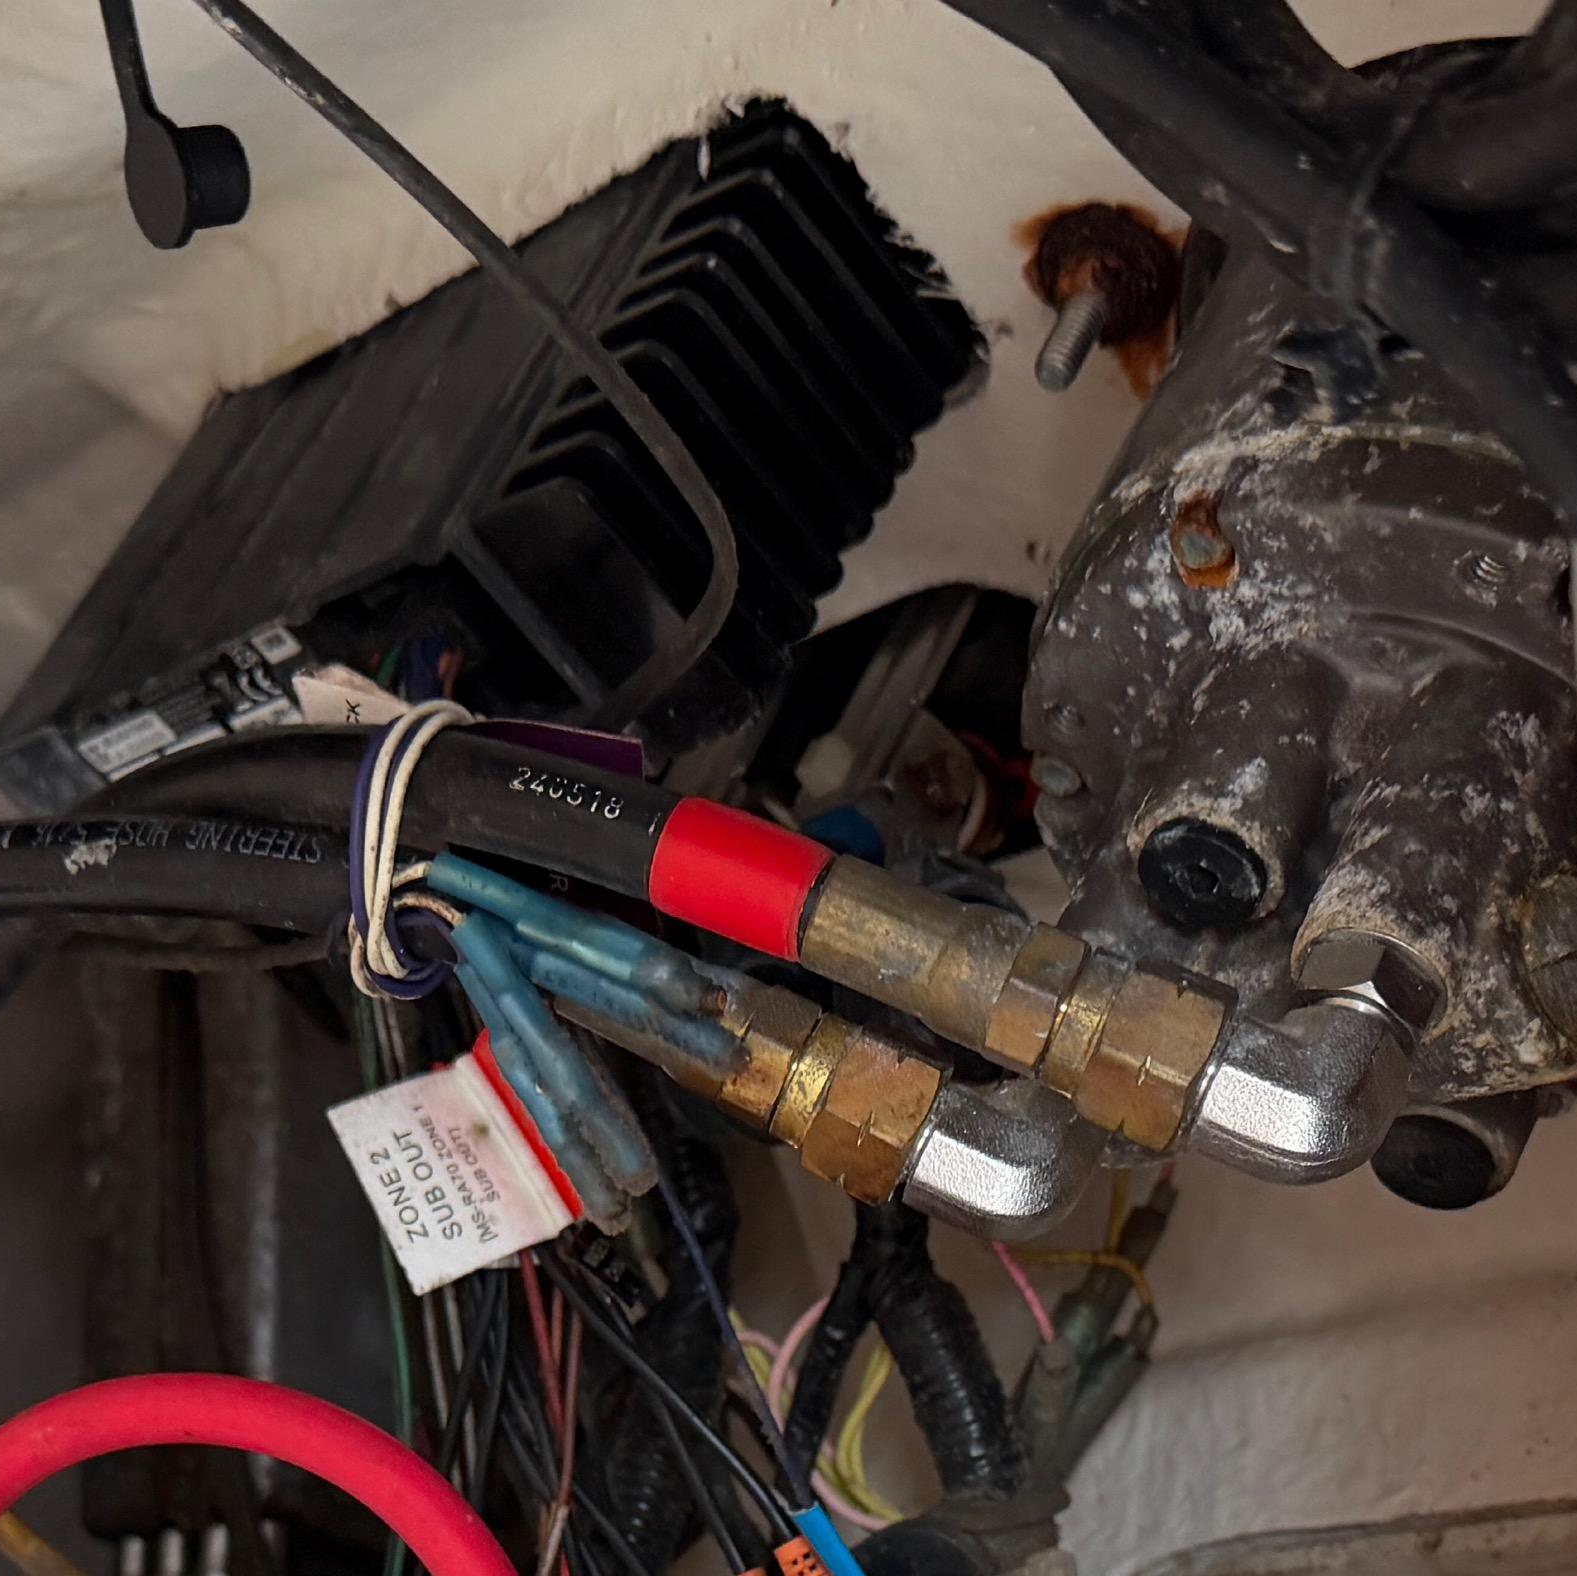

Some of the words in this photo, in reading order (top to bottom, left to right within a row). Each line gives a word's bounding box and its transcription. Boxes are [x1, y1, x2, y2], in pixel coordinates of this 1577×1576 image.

[185, 820, 323, 863] STEERING
[370, 1147, 390, 1165] 2
[393, 1128, 433, 1181] OUT
[420, 1115, 453, 1160] ZONE
[380, 1167, 429, 1243] ZONE
[474, 1167, 500, 1203] SUB
[425, 1185, 463, 1240] SUB
